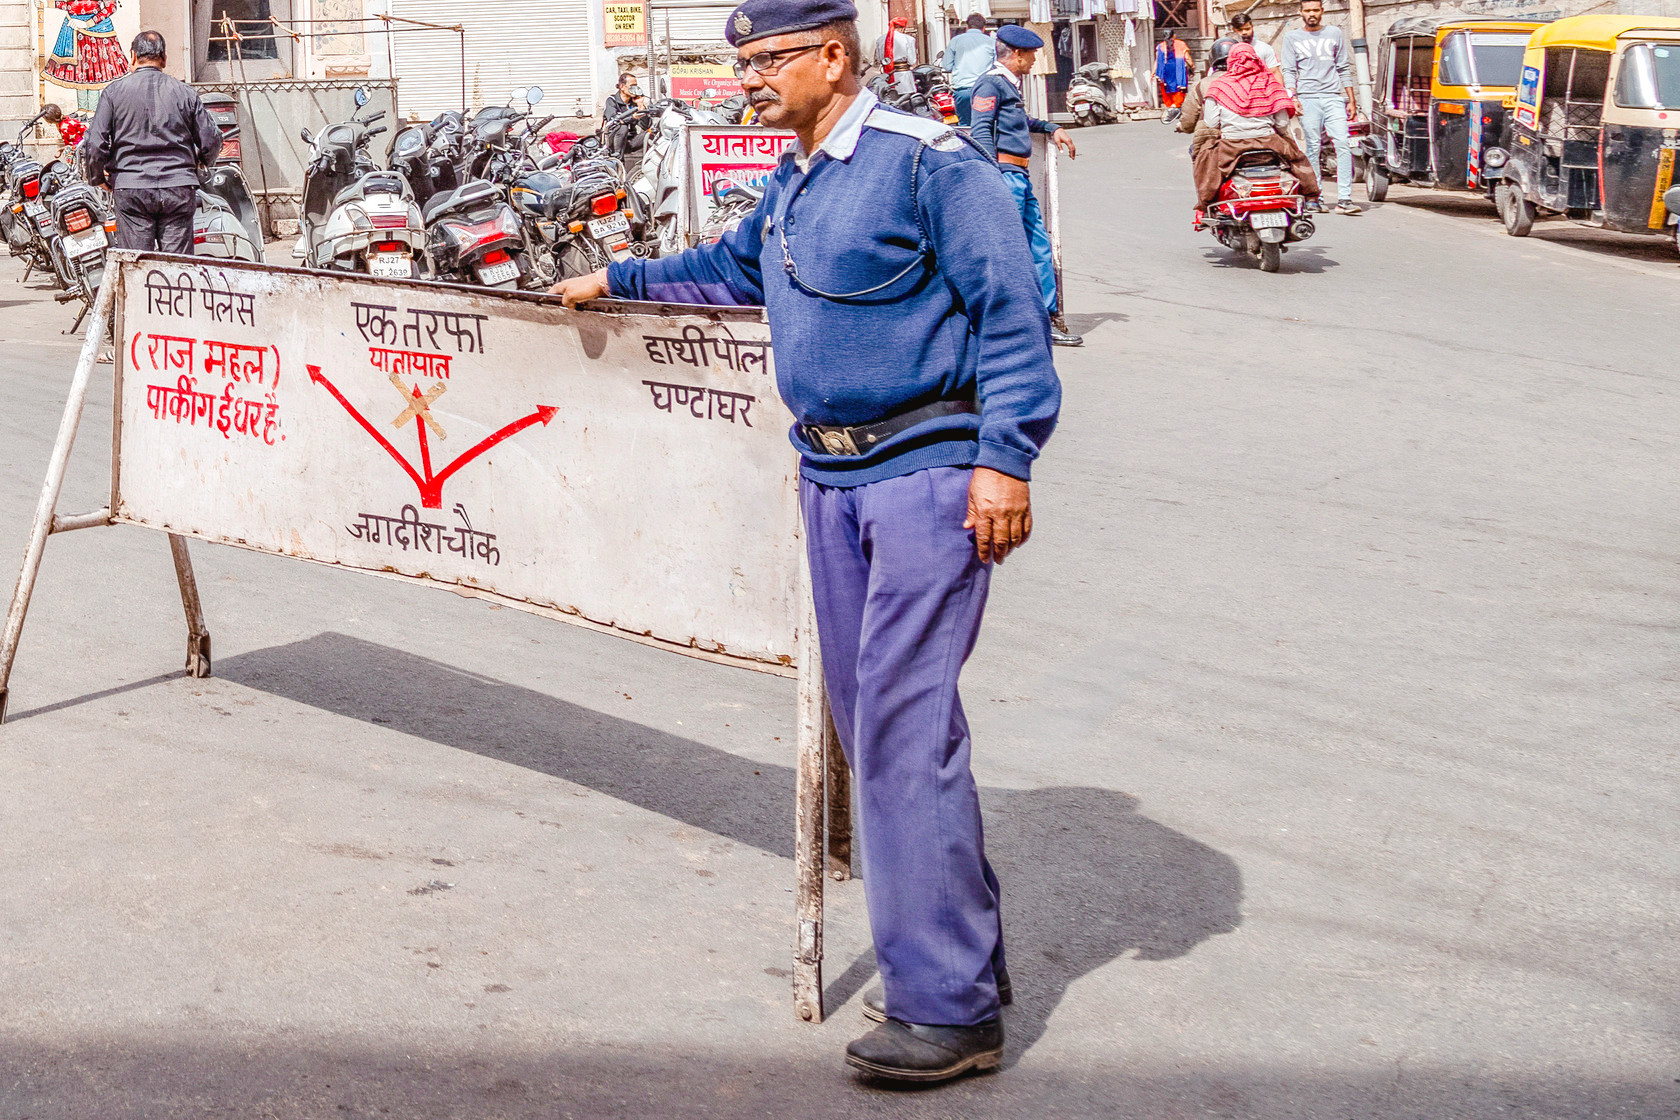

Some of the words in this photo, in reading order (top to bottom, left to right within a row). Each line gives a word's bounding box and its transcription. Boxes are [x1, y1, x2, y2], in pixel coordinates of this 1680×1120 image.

[680, 88, 694, 96] Music
[703, 170, 724, 192] NO
[594, 226, 605, 234] SA
[144, 269, 196, 318] सिटी
[199, 266, 256, 327] पैलेस
[351, 302, 397, 345] एक
[403, 308, 489, 354] तरफा
[203, 340, 281, 390] महल)
[368, 346, 453, 380] यातायात
[345, 503, 447, 555] जगदीश
[442, 503, 501, 566] चौक
